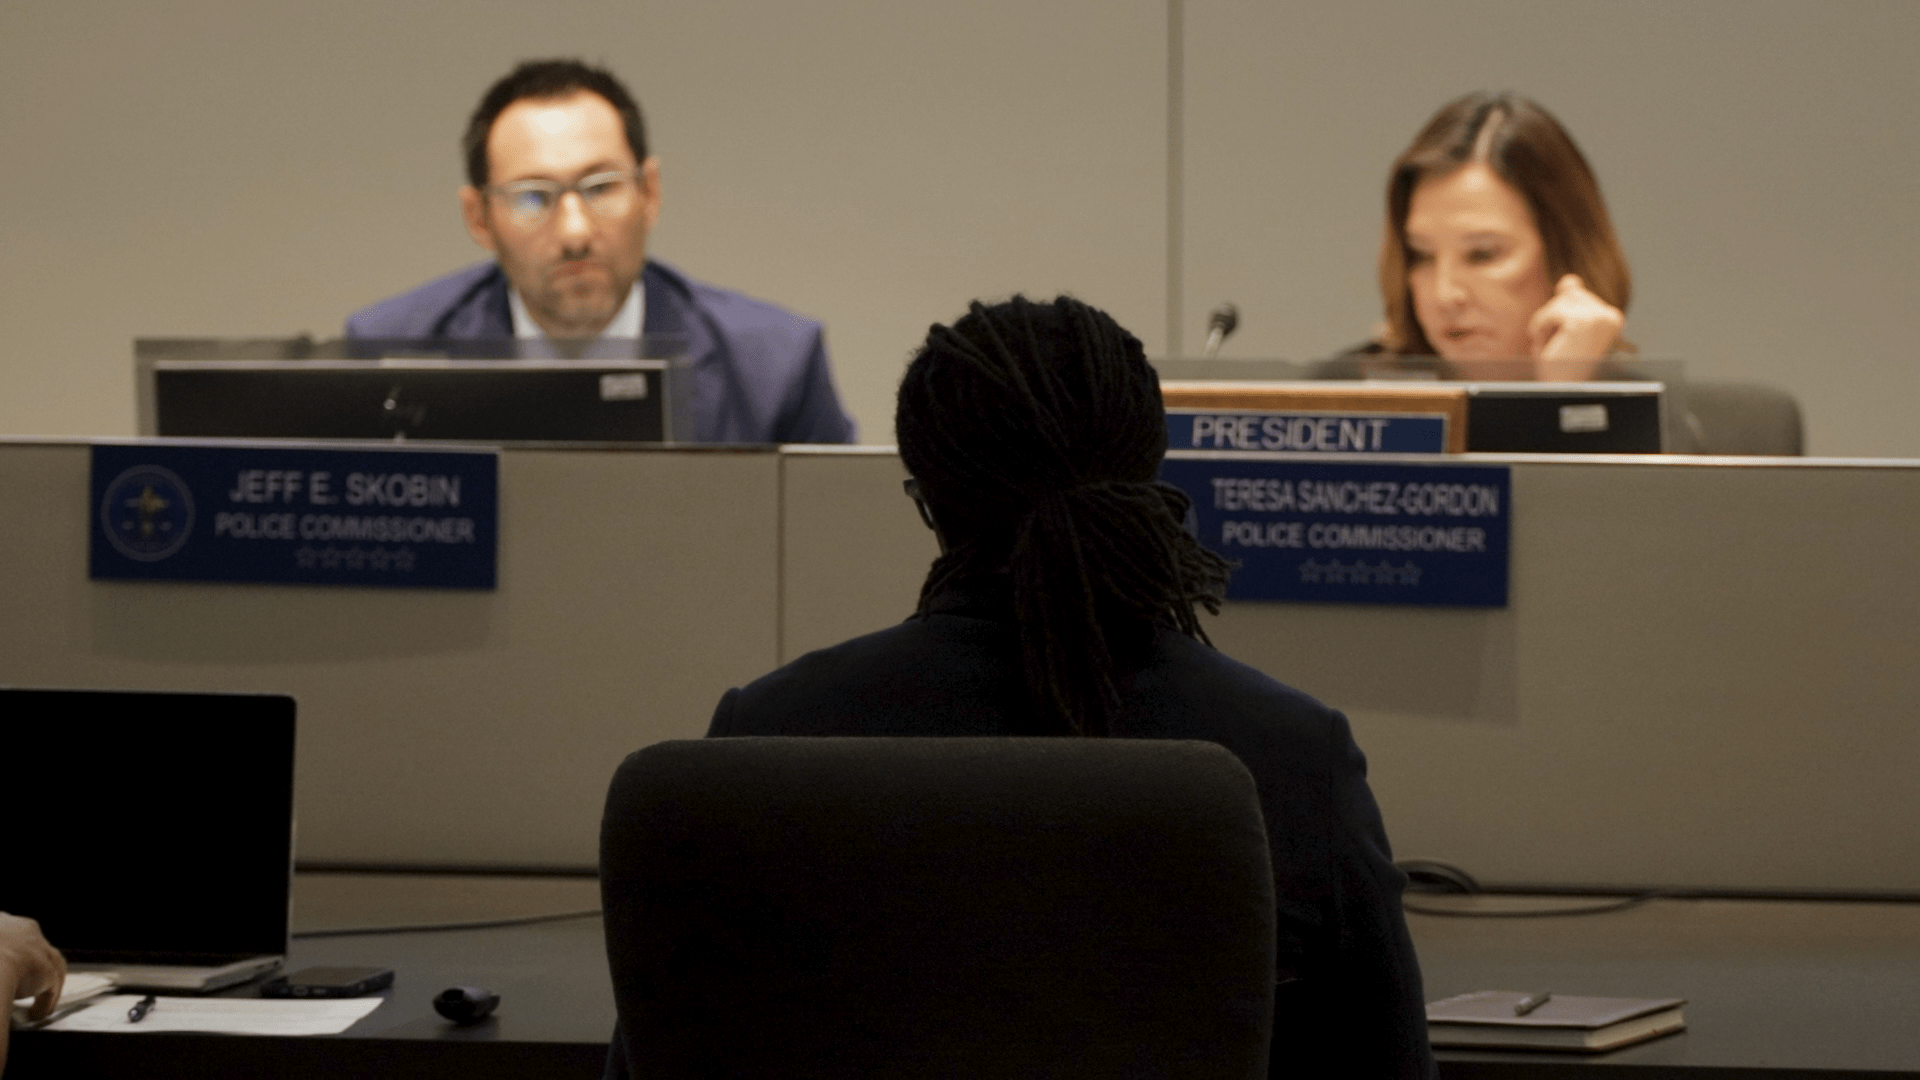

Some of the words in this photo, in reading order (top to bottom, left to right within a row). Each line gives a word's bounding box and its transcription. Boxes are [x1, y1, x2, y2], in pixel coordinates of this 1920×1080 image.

[1192, 416, 1387, 450] PRESIDENT
[230, 470, 303, 502] JEFF
[310, 471, 337, 504] E.
[346, 473, 461, 507] SKOBIN
[1212, 478, 1296, 511] TERESA
[1299, 481, 1498, 516] SANCHEZ-GORDON
[215, 513, 296, 539] POLICE
[301, 516, 474, 542] COMMISSIONER
[1222, 521, 1304, 548] POLICE
[1309, 525, 1485, 551] COMMISSIONER
